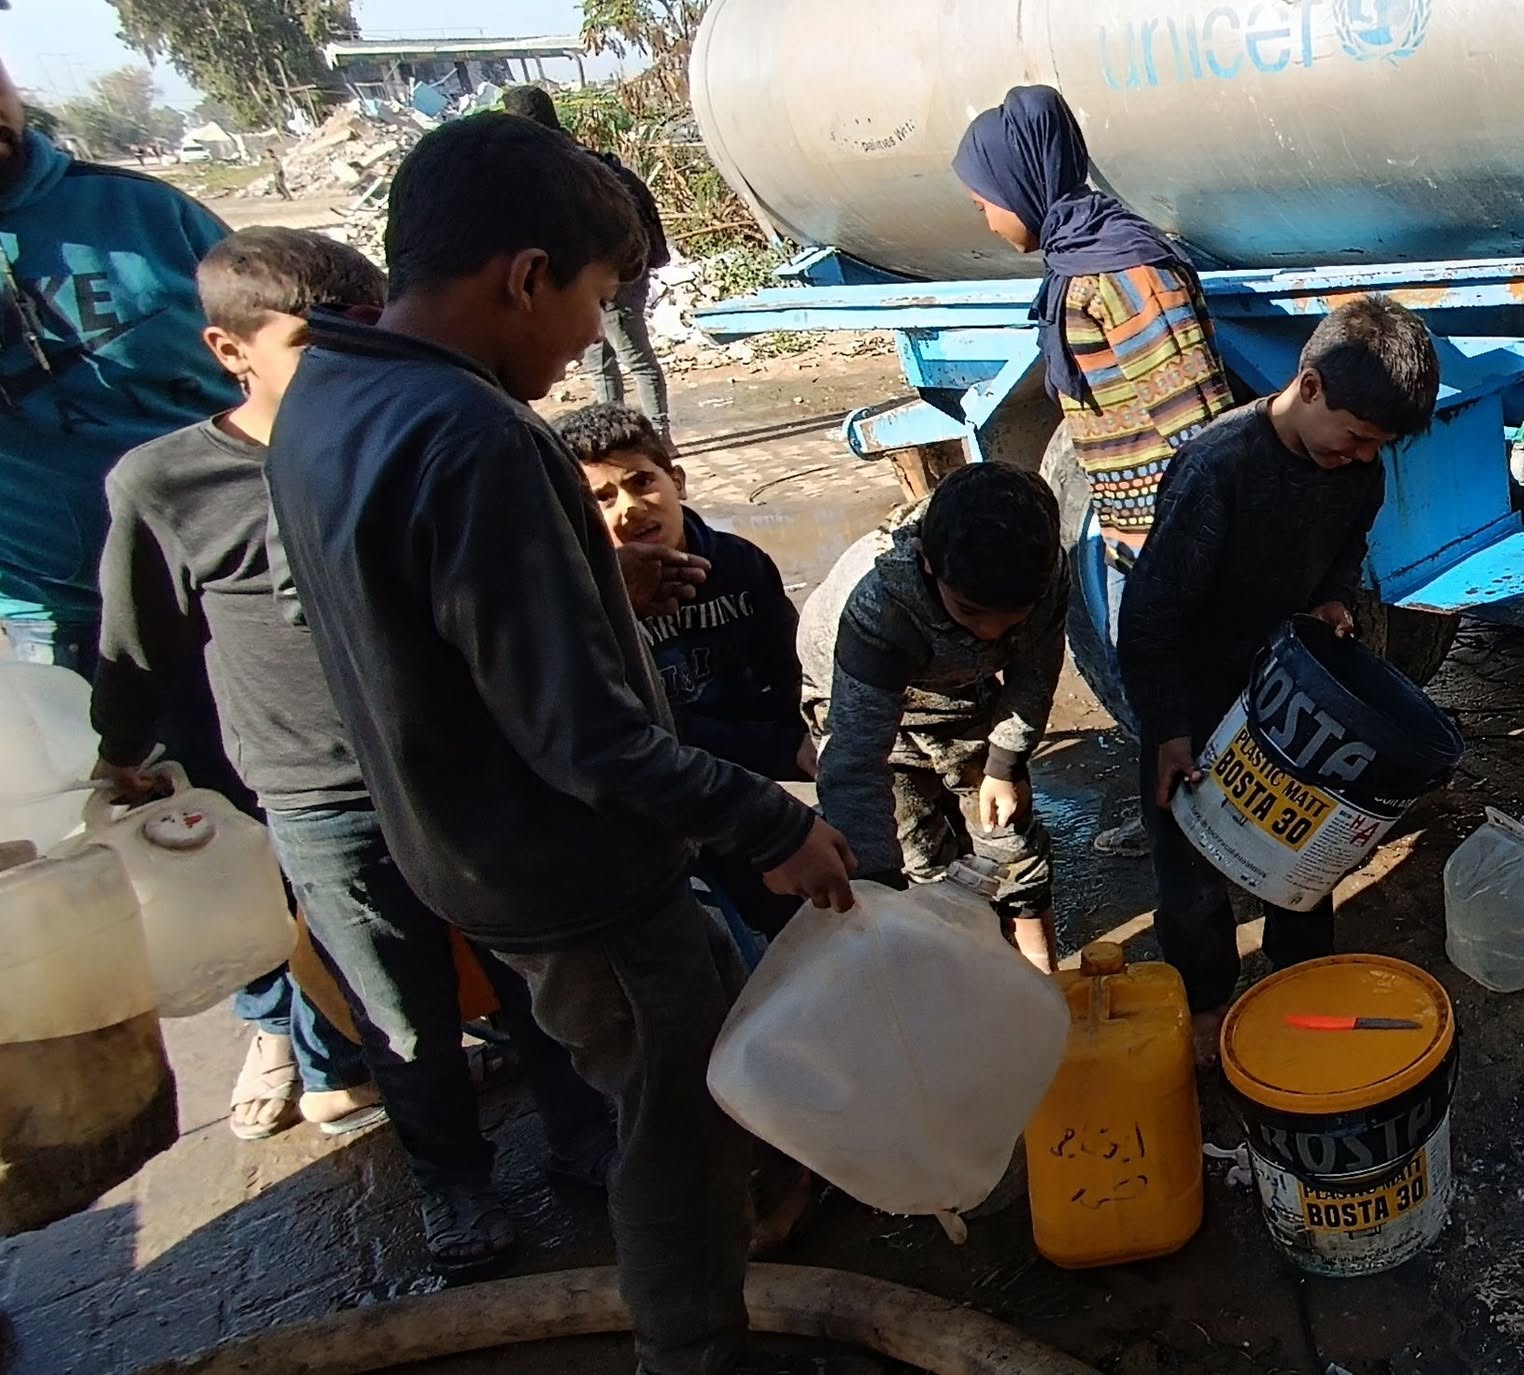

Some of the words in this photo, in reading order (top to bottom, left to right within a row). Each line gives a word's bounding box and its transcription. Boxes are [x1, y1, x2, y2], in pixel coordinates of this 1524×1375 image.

[1256, 660, 1377, 782] OSTA
[1214, 748, 1278, 822] BOSTA
[1271, 807, 1313, 845] 30
[1235, 729, 1286, 787] PLASTIC
[1281, 780, 1330, 818] MATT
[1306, 1194, 1389, 1228] BOSTA
[1396, 1175, 1424, 1211] 30
